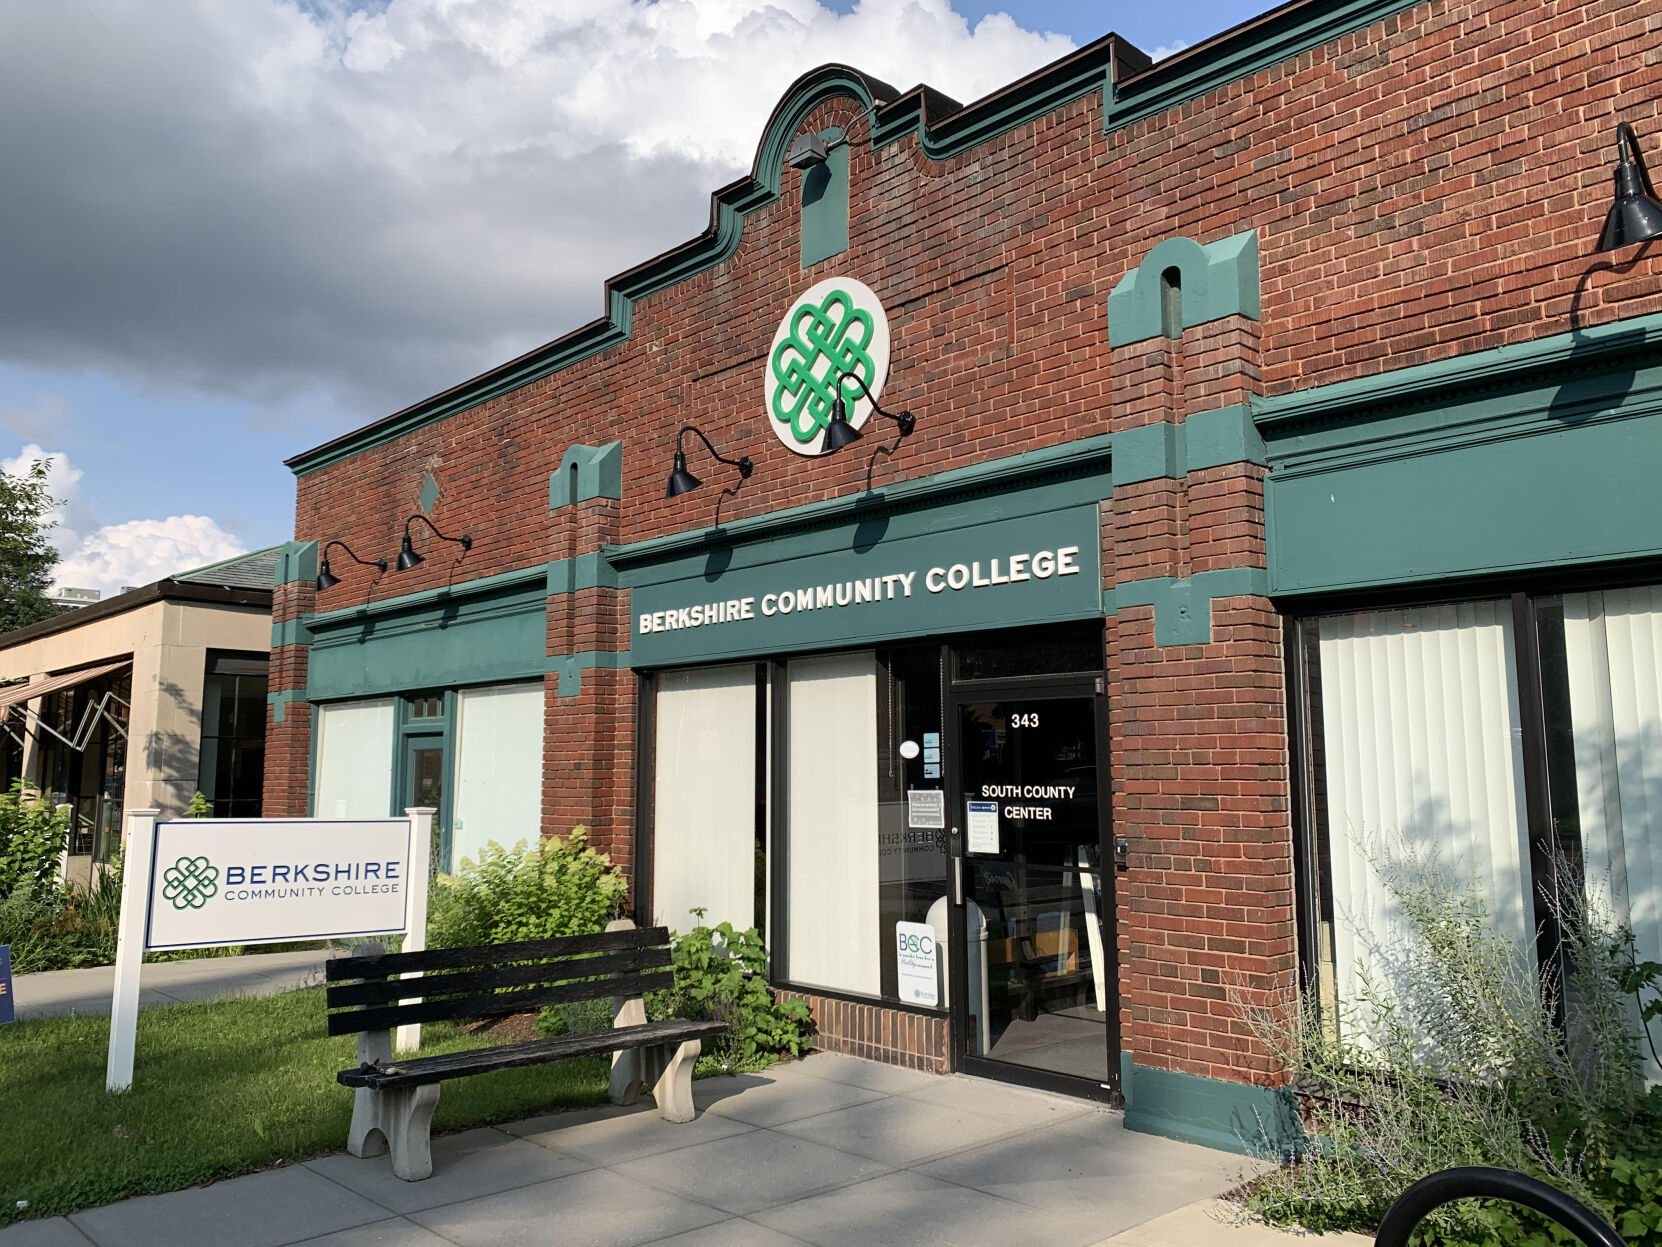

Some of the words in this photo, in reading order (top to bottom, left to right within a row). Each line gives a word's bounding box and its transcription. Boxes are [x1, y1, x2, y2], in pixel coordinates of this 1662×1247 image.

[639, 597, 755, 634] BERKSHIRE
[761, 571, 918, 616] COMMUNITY
[925, 546, 1080, 593] COLLEGE
[1011, 713, 1039, 728] 343
[982, 785, 1021, 798] SOUTH
[1023, 785, 1076, 799] COUNTY
[1004, 806, 1052, 820] CENTER
[226, 861, 400, 886] BERKSHIRE
[224, 887, 325, 901] COMMUNITY
[331, 883, 399, 896] COLLEGE
